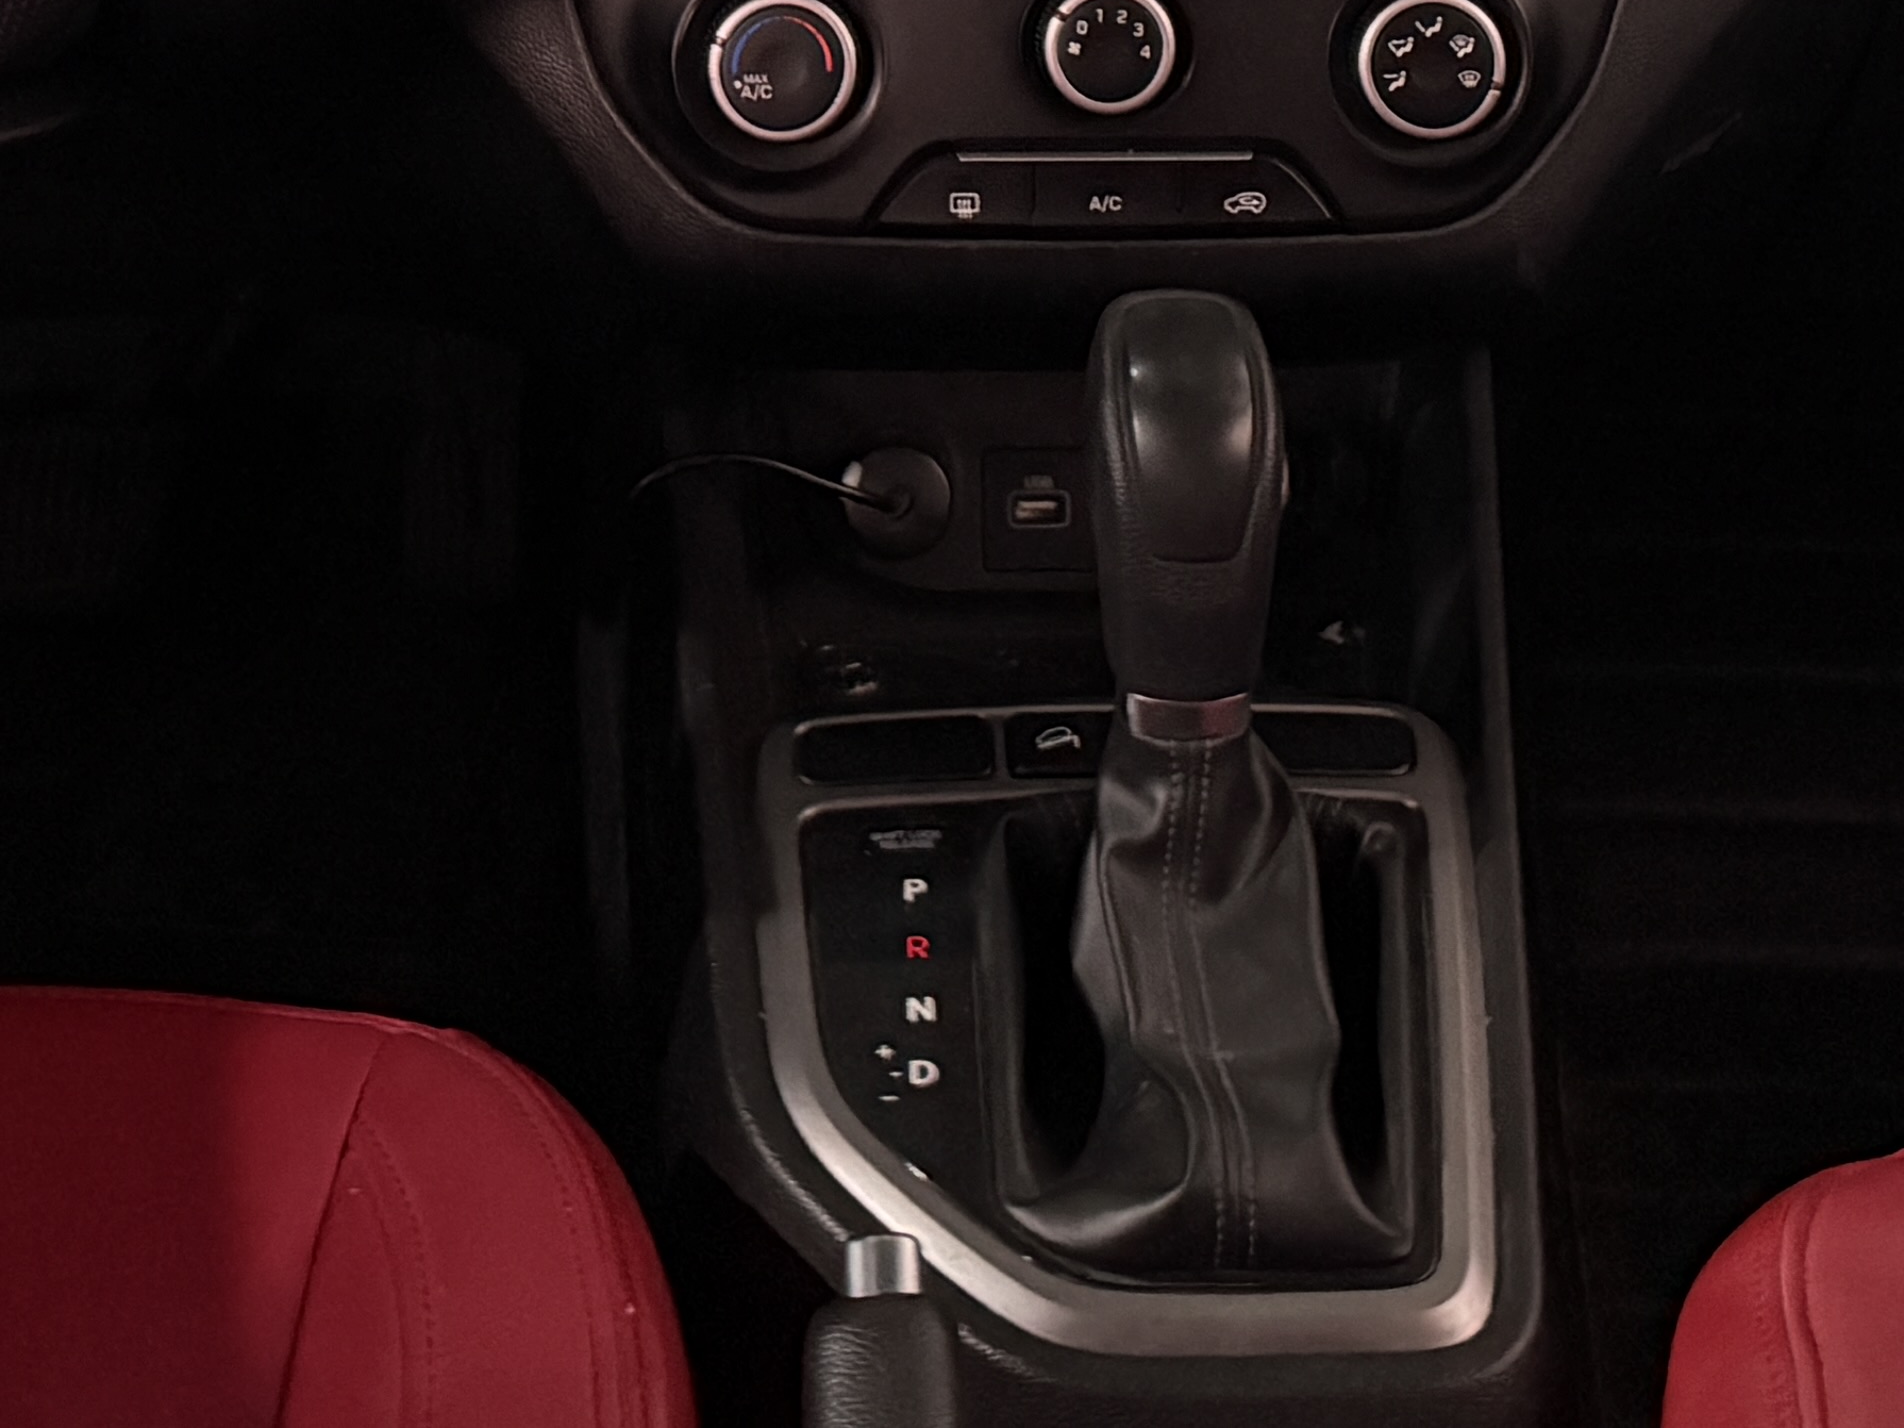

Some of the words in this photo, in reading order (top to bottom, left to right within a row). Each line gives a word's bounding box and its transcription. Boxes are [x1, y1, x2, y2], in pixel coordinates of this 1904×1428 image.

[1116, 9, 1129, 25] 2
[1075, 19, 1089, 36] 0
[1132, 22, 1145, 38] 3
[1139, 44, 1152, 60] 4
[743, 73, 769, 84] MAX
[740, 84, 774, 102] A/C
[1088, 194, 1124, 215] A/C
[902, 877, 929, 904] P
[905, 935, 932, 960] R
[905, 996, 938, 1023] N
[907, 1059, 939, 1086] D
